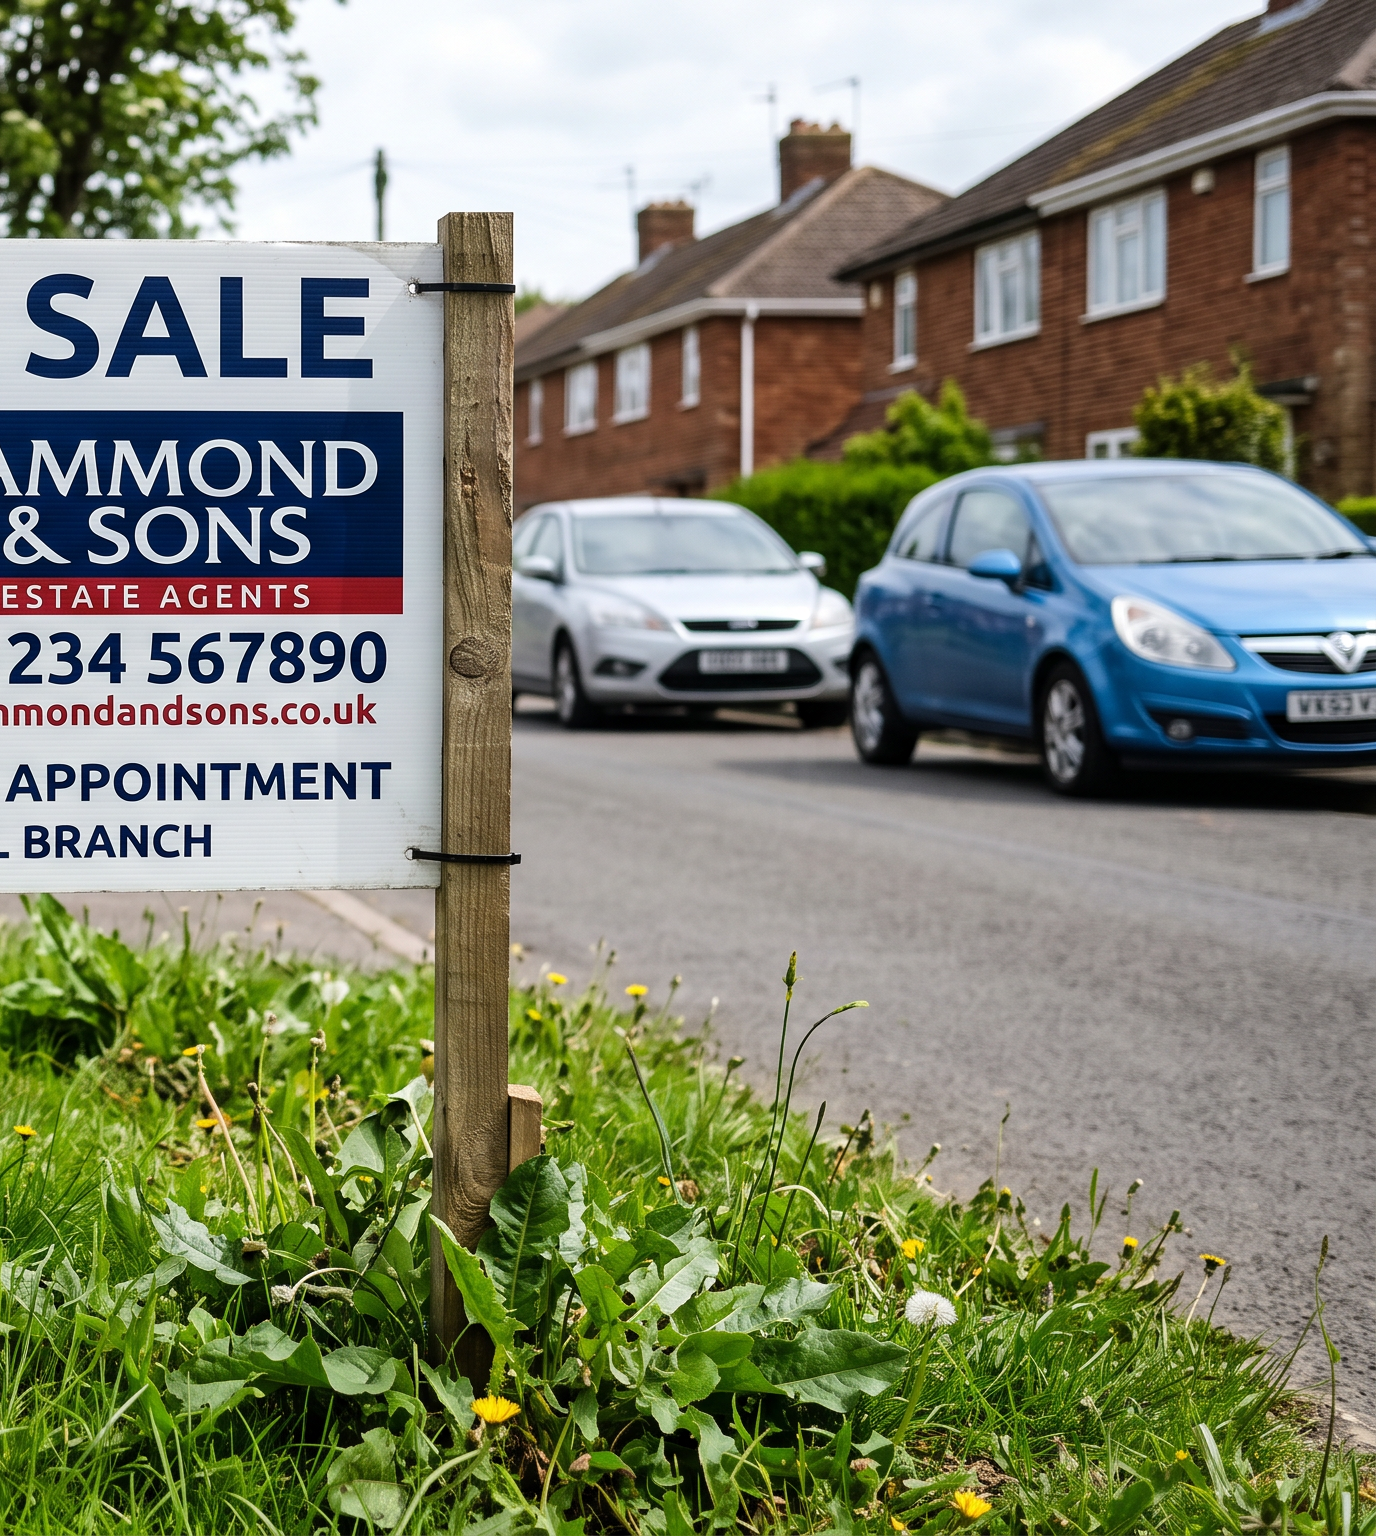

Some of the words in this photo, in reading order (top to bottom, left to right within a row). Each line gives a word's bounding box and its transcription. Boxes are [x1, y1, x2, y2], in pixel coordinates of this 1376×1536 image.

[25, 274, 373, 379] SALE
[3, 506, 71, 564] &
[88, 506, 310, 564] SONS
[3, 585, 139, 608] ESTATE
[160, 585, 309, 608] AGENTS
[148, 631, 386, 684] 567890
[5, 762, 391, 802] APPOINTMENT
[25, 824, 211, 858] BRANCH
